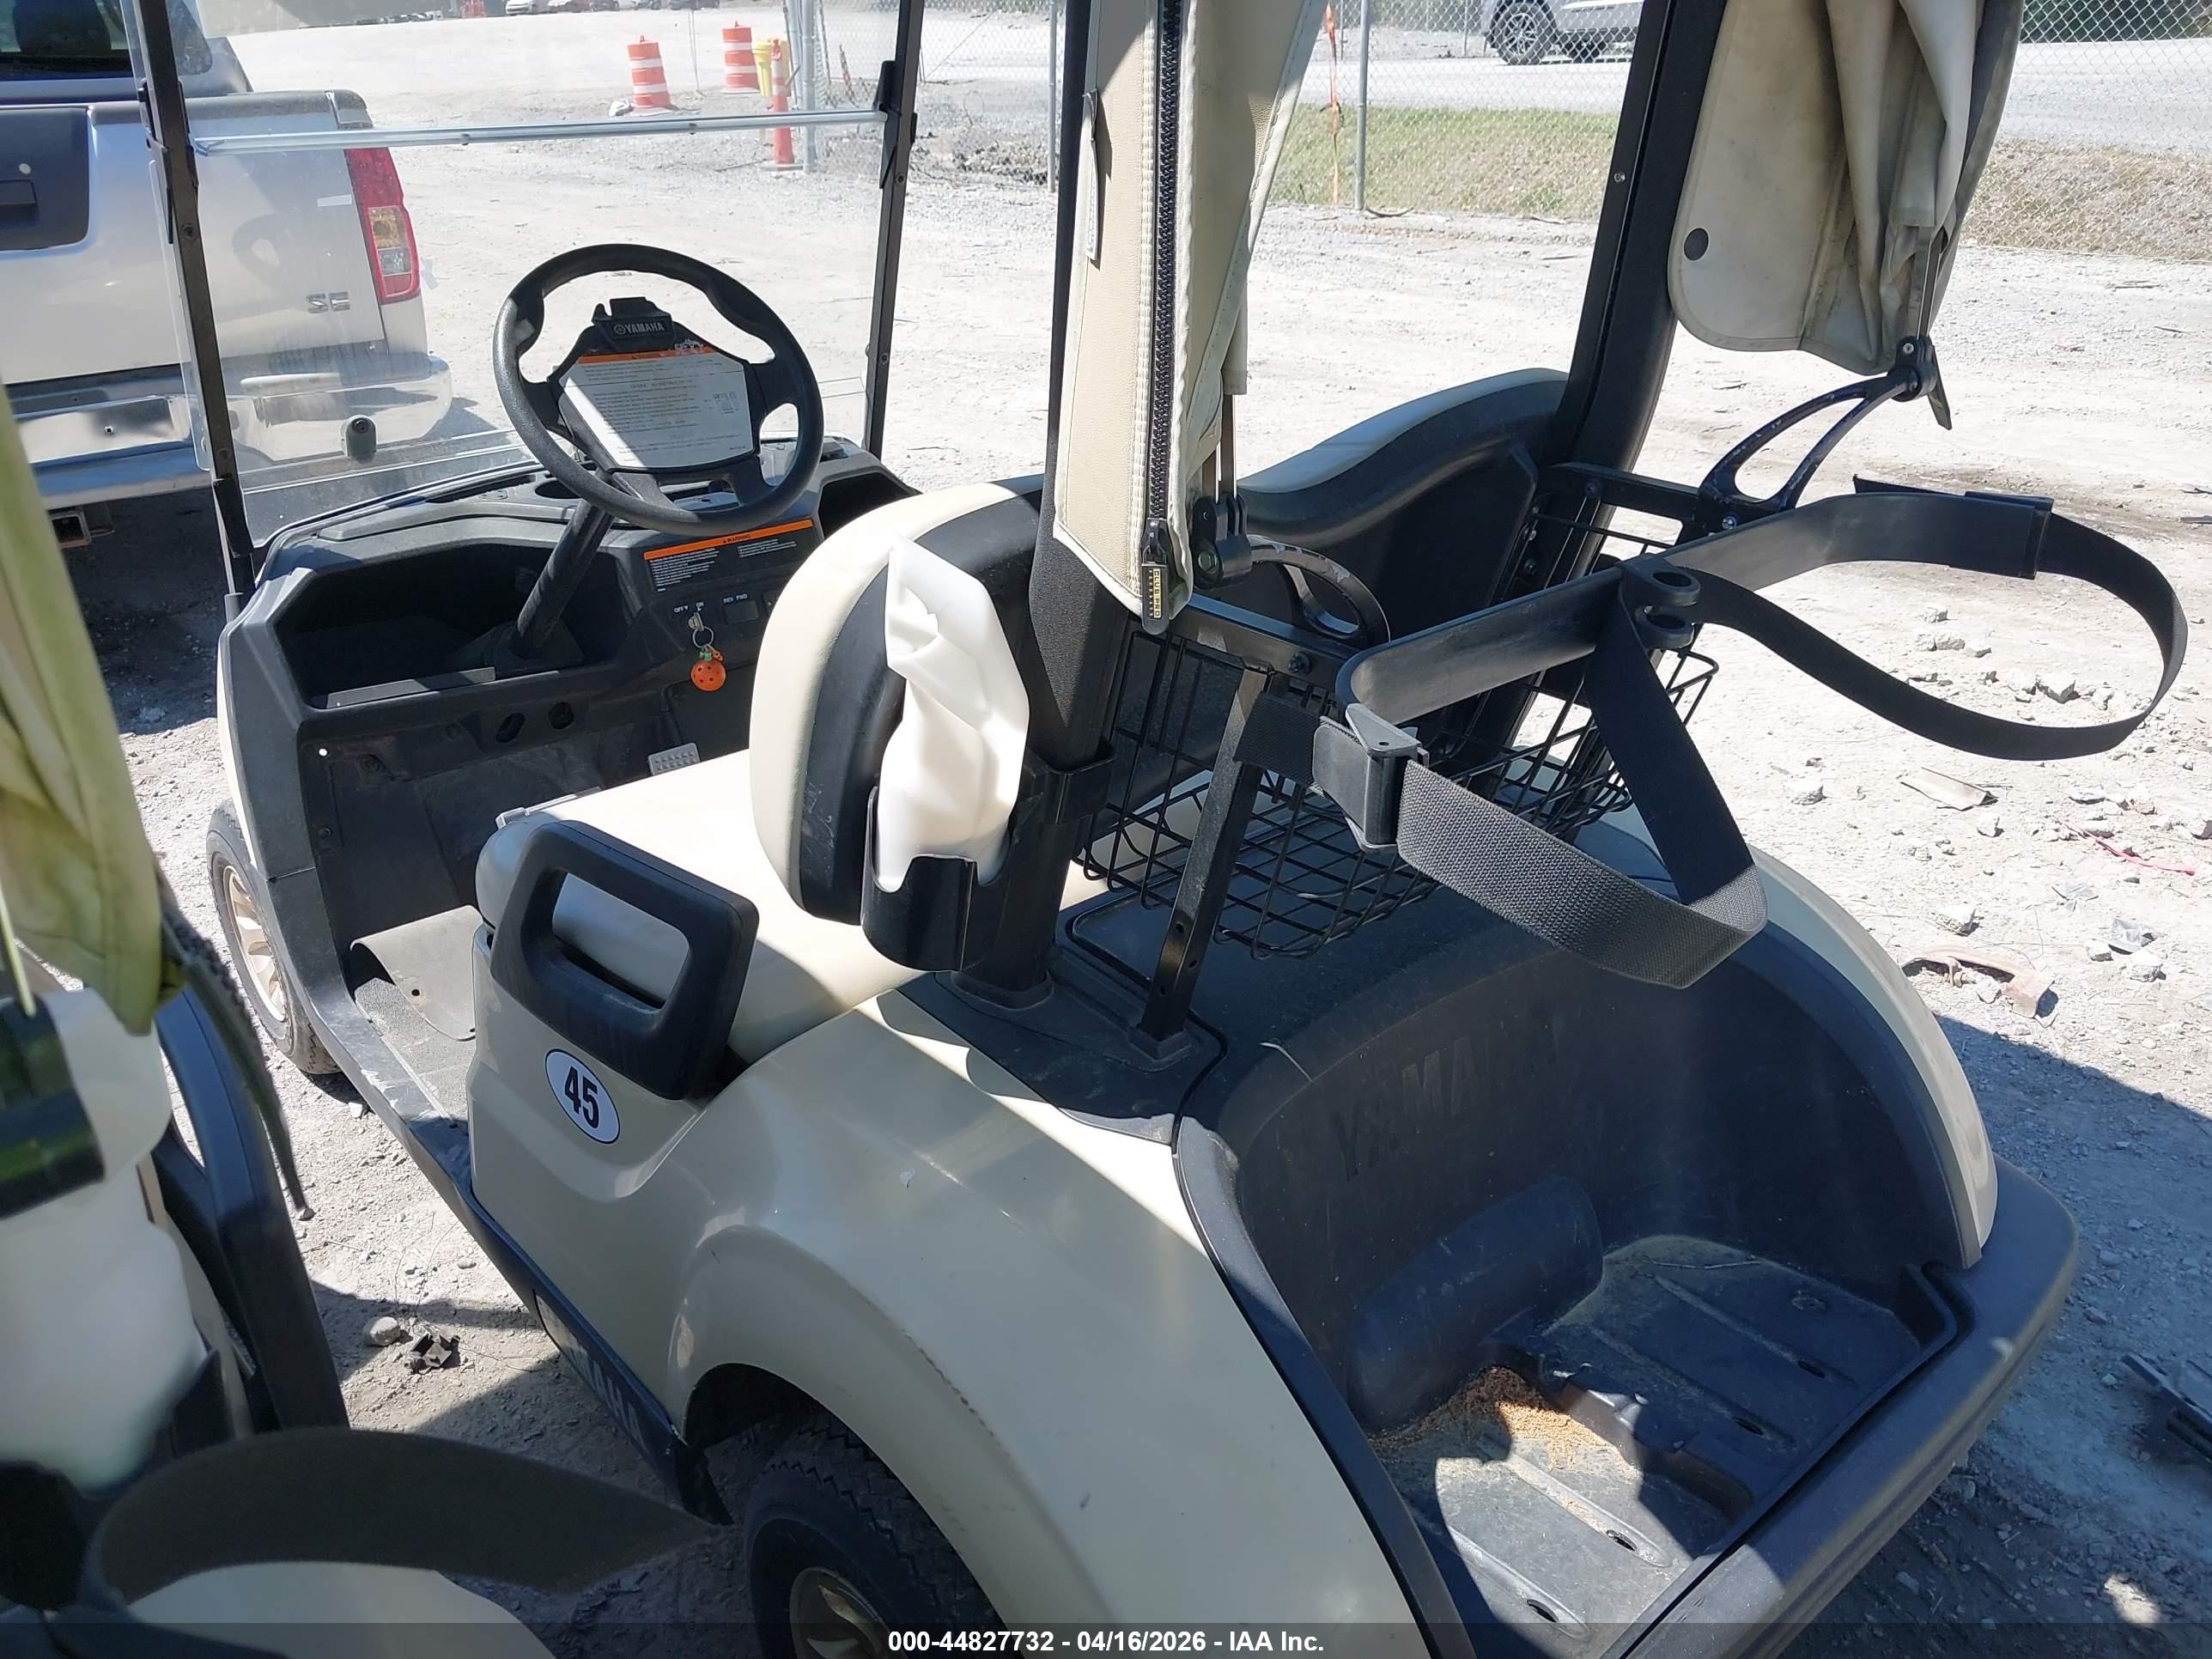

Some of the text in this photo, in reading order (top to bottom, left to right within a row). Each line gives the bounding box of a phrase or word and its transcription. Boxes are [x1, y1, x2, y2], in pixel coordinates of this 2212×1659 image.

[306, 291, 351, 314] SE
[624, 322, 665, 334] YAMAHA
[735, 592, 748, 601] FWD
[564, 1066, 599, 1128] 45
[1331, 1003, 1575, 1183] YAMA
